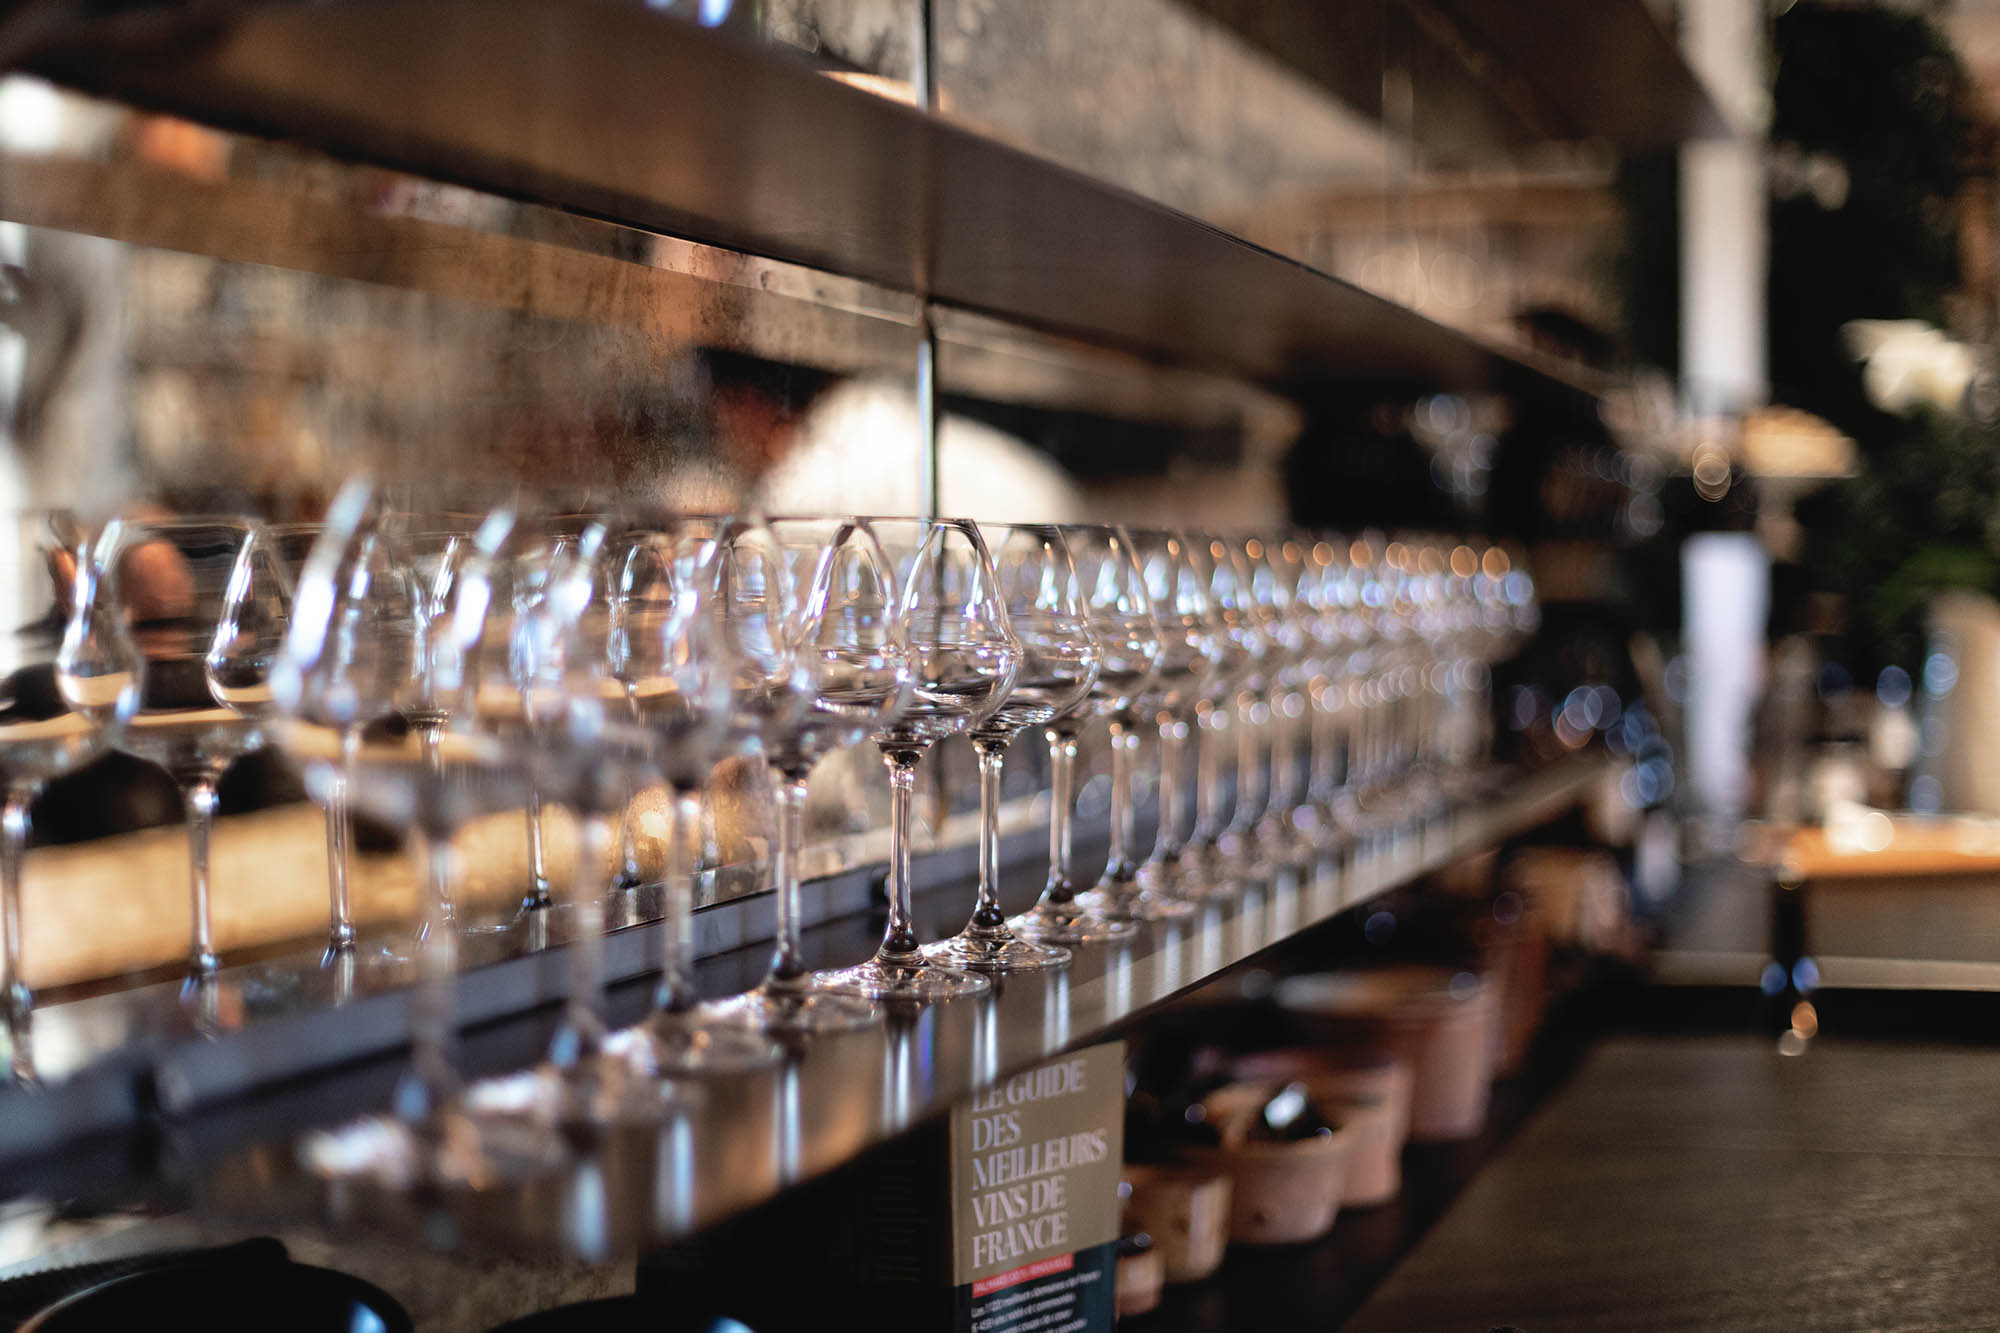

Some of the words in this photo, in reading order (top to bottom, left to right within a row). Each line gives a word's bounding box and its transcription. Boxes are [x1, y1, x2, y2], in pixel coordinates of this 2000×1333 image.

[1007, 1060, 1086, 1105] GUIDE
[972, 1110, 1021, 1152] DES
[972, 1128, 1108, 1191] MEILLEURS
[971, 1184, 1028, 1228] VINS
[1031, 1175, 1066, 1213] DE
[972, 1211, 1068, 1268] FRANCE
